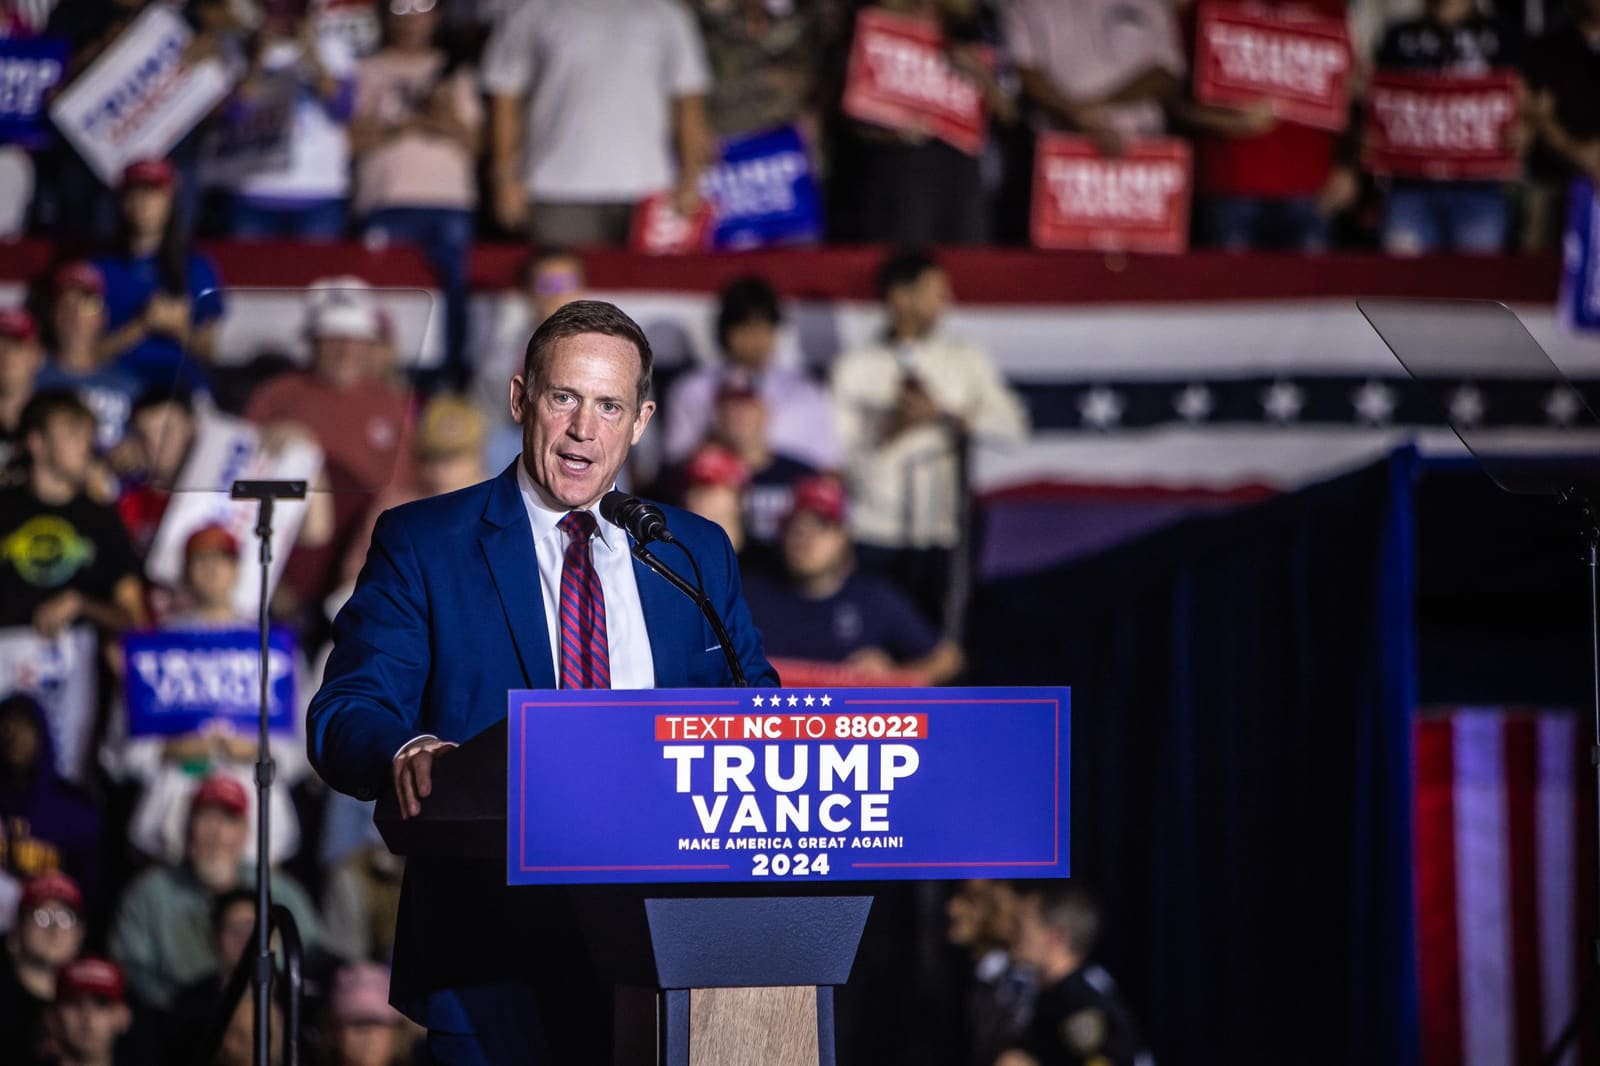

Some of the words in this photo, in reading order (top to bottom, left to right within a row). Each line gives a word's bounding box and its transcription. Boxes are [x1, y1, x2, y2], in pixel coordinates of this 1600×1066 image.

[665, 716, 735, 740] TEXT
[743, 716, 783, 739] NC
[789, 716, 826, 738] TO
[834, 715, 918, 738] 88022
[663, 743, 920, 793] TRUMP
[691, 793, 890, 834] VANCE
[678, 838, 720, 851] MAKE
[724, 837, 793, 850] AMERICA
[797, 837, 847, 849] GREAT
[851, 836, 904, 848] AGAIN!
[751, 853, 830, 876] 2024
